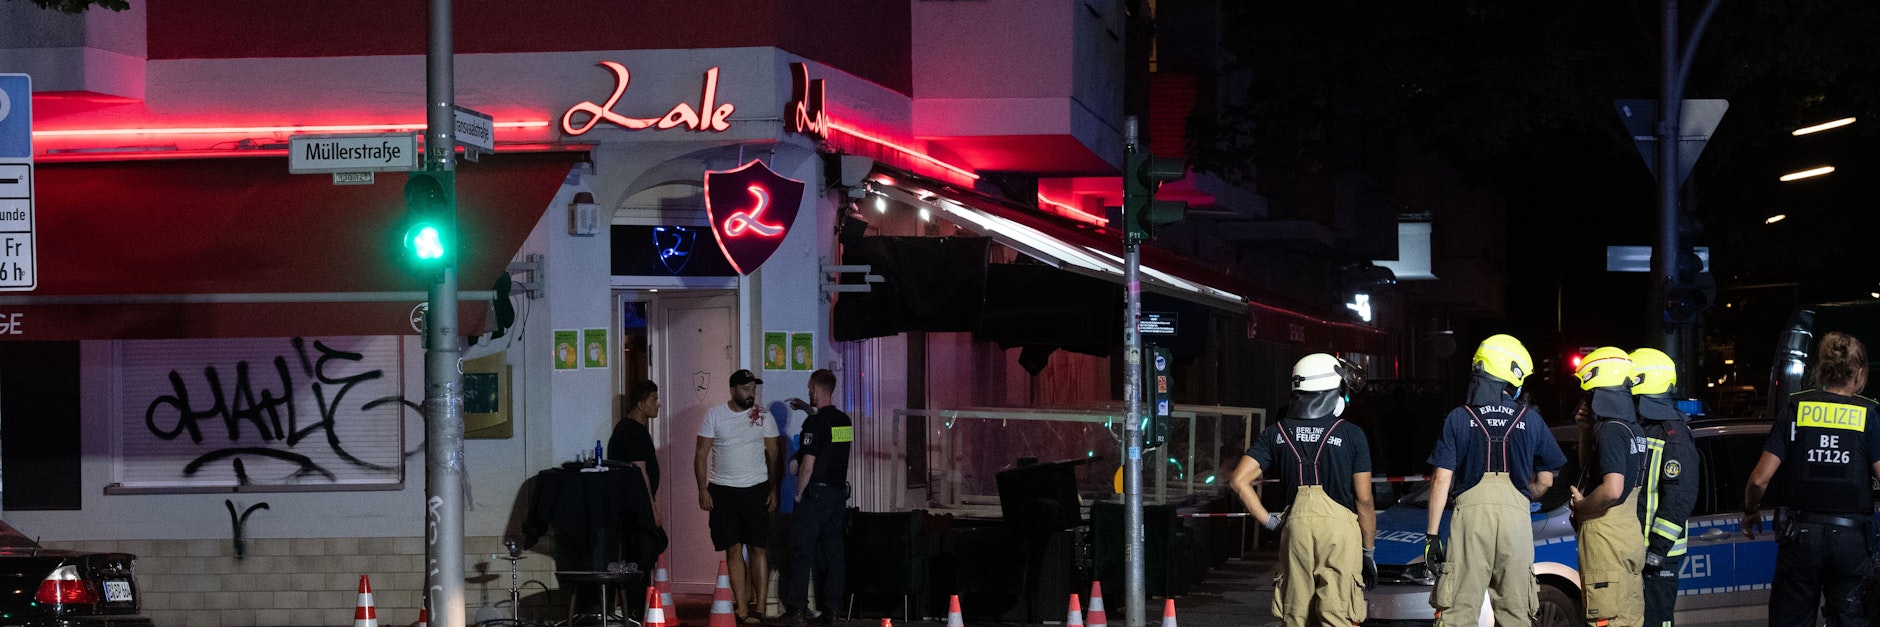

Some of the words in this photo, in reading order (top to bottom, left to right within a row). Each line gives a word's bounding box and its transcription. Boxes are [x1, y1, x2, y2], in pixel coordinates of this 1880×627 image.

[562, 60, 735, 136] Lale
[455, 113, 489, 144] ransvaalstraße
[305, 141, 401, 163] Müllerstraße
[5, 237, 22, 257] Fr
[13, 262, 22, 281] h
[1801, 405, 1863, 427] POLIZEI
[1296, 426, 1324, 435] BERLINE
[1296, 433, 1342, 447] FEUEREHR
[1819, 434, 1840, 449] BE
[1807, 448, 1850, 464] 1T126
